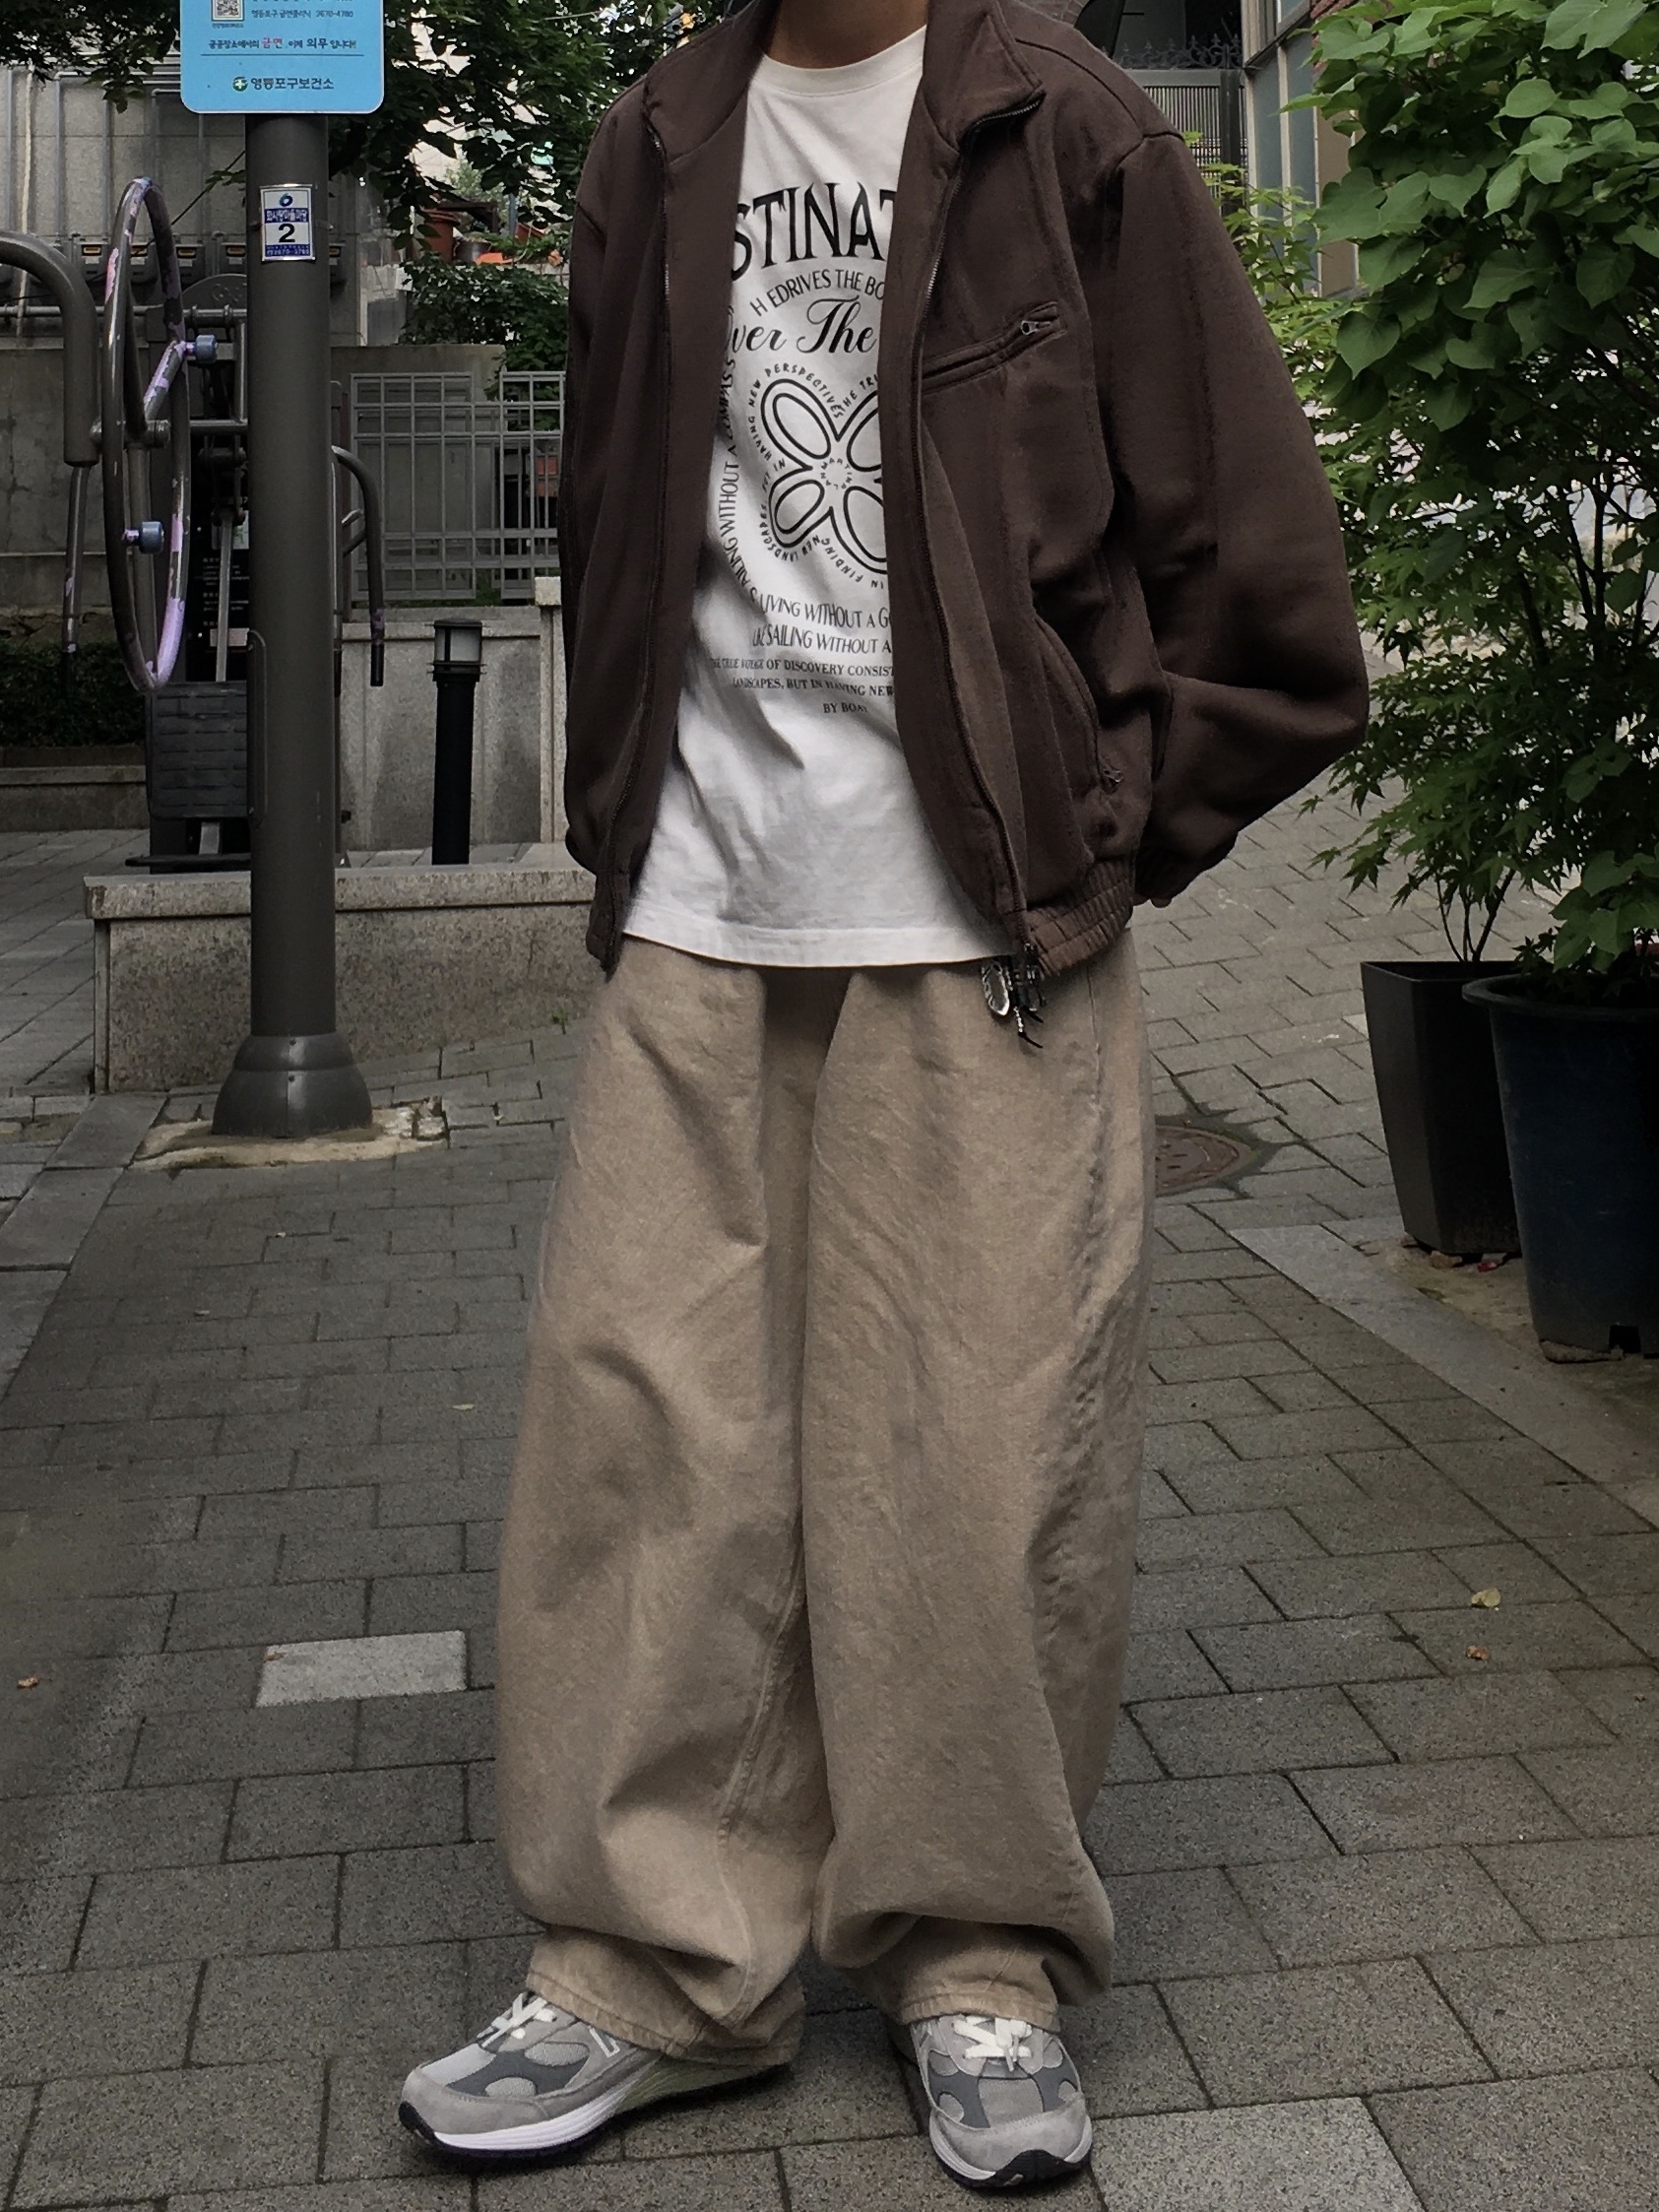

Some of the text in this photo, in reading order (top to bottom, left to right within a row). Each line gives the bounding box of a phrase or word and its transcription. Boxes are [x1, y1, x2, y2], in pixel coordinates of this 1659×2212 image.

[306, 37, 328, 49] 의무
[250, 78, 334, 91] 영등포구보건소
[279, 223, 295, 243] 2
[835, 269, 864, 292] THE
[797, 294, 877, 354] The
[719, 461, 739, 538] WITHOUT
[821, 538, 864, 583] FINDING
[804, 603, 862, 628] WITHOUT
[866, 614, 876, 628] A
[816, 632, 878, 654] WITHOUT
[766, 659, 781, 670] OF
[784, 660, 845, 676] DISCOVERY
[823, 703, 837, 713] BY
